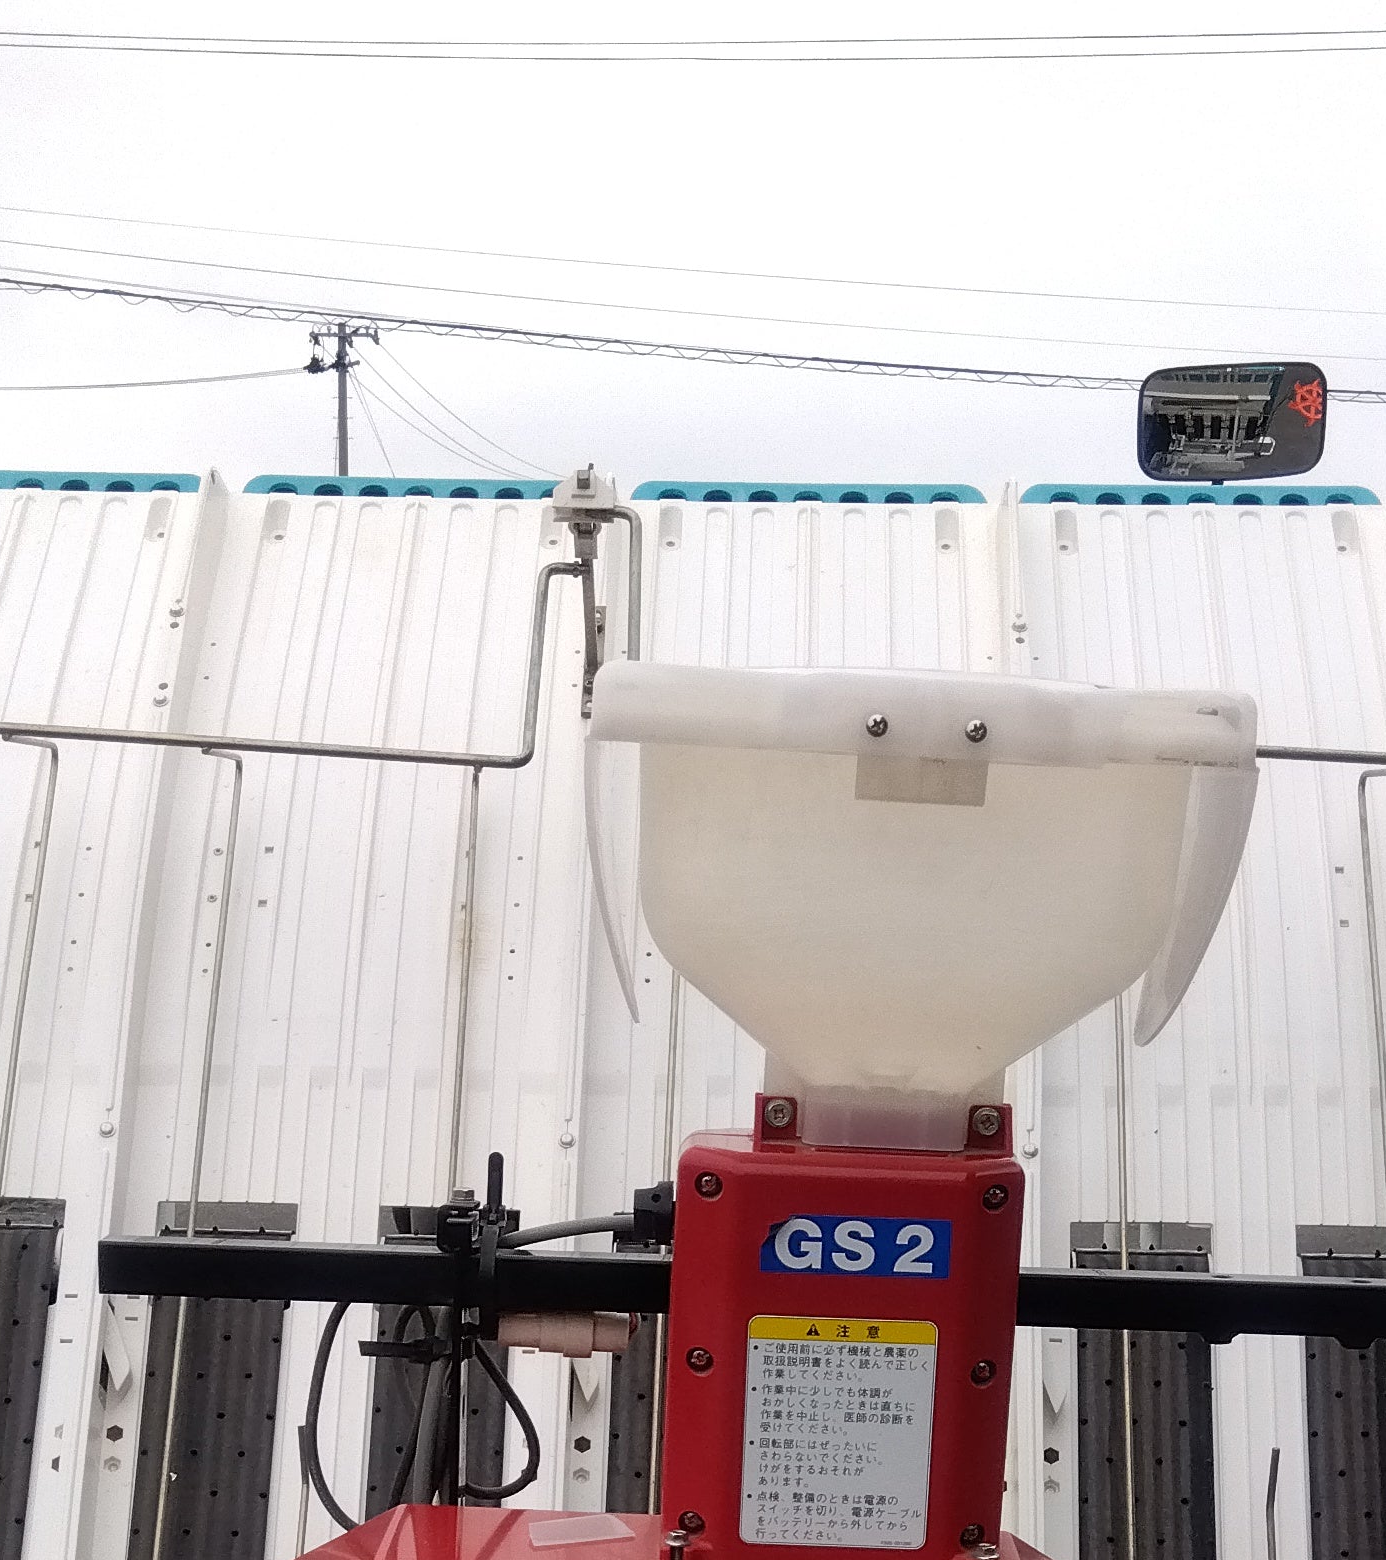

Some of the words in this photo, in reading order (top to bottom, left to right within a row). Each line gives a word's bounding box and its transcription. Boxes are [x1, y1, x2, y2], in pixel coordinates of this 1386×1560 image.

[774, 1218, 876, 1272] GS
[893, 1223, 935, 1274] 2
[836, 1324, 880, 1339] 注意
[764, 1342, 919, 1358] ご使用前に必ず機械と農薬の
[763, 1355, 929, 1371] 取扱説明書をよく読んで正しく
[762, 1368, 863, 1382] 作業してください。
[761, 1384, 893, 1398] 作業中に少しでも体調が
[761, 1398, 915, 1412] おかしくなったときは直ちに
[759, 1422, 848, 1436] 受けてください。
[759, 1437, 878, 1452] 回転部にはぜったいに
[760, 1450, 883, 1465] さわらないでください。
[759, 1463, 864, 1477] けがをするおそれが
[758, 1476, 809, 1488] あります。
[757, 1516, 908, 1531] をバッテリーから外してから
[755, 1529, 843, 1542] 行ってください。
